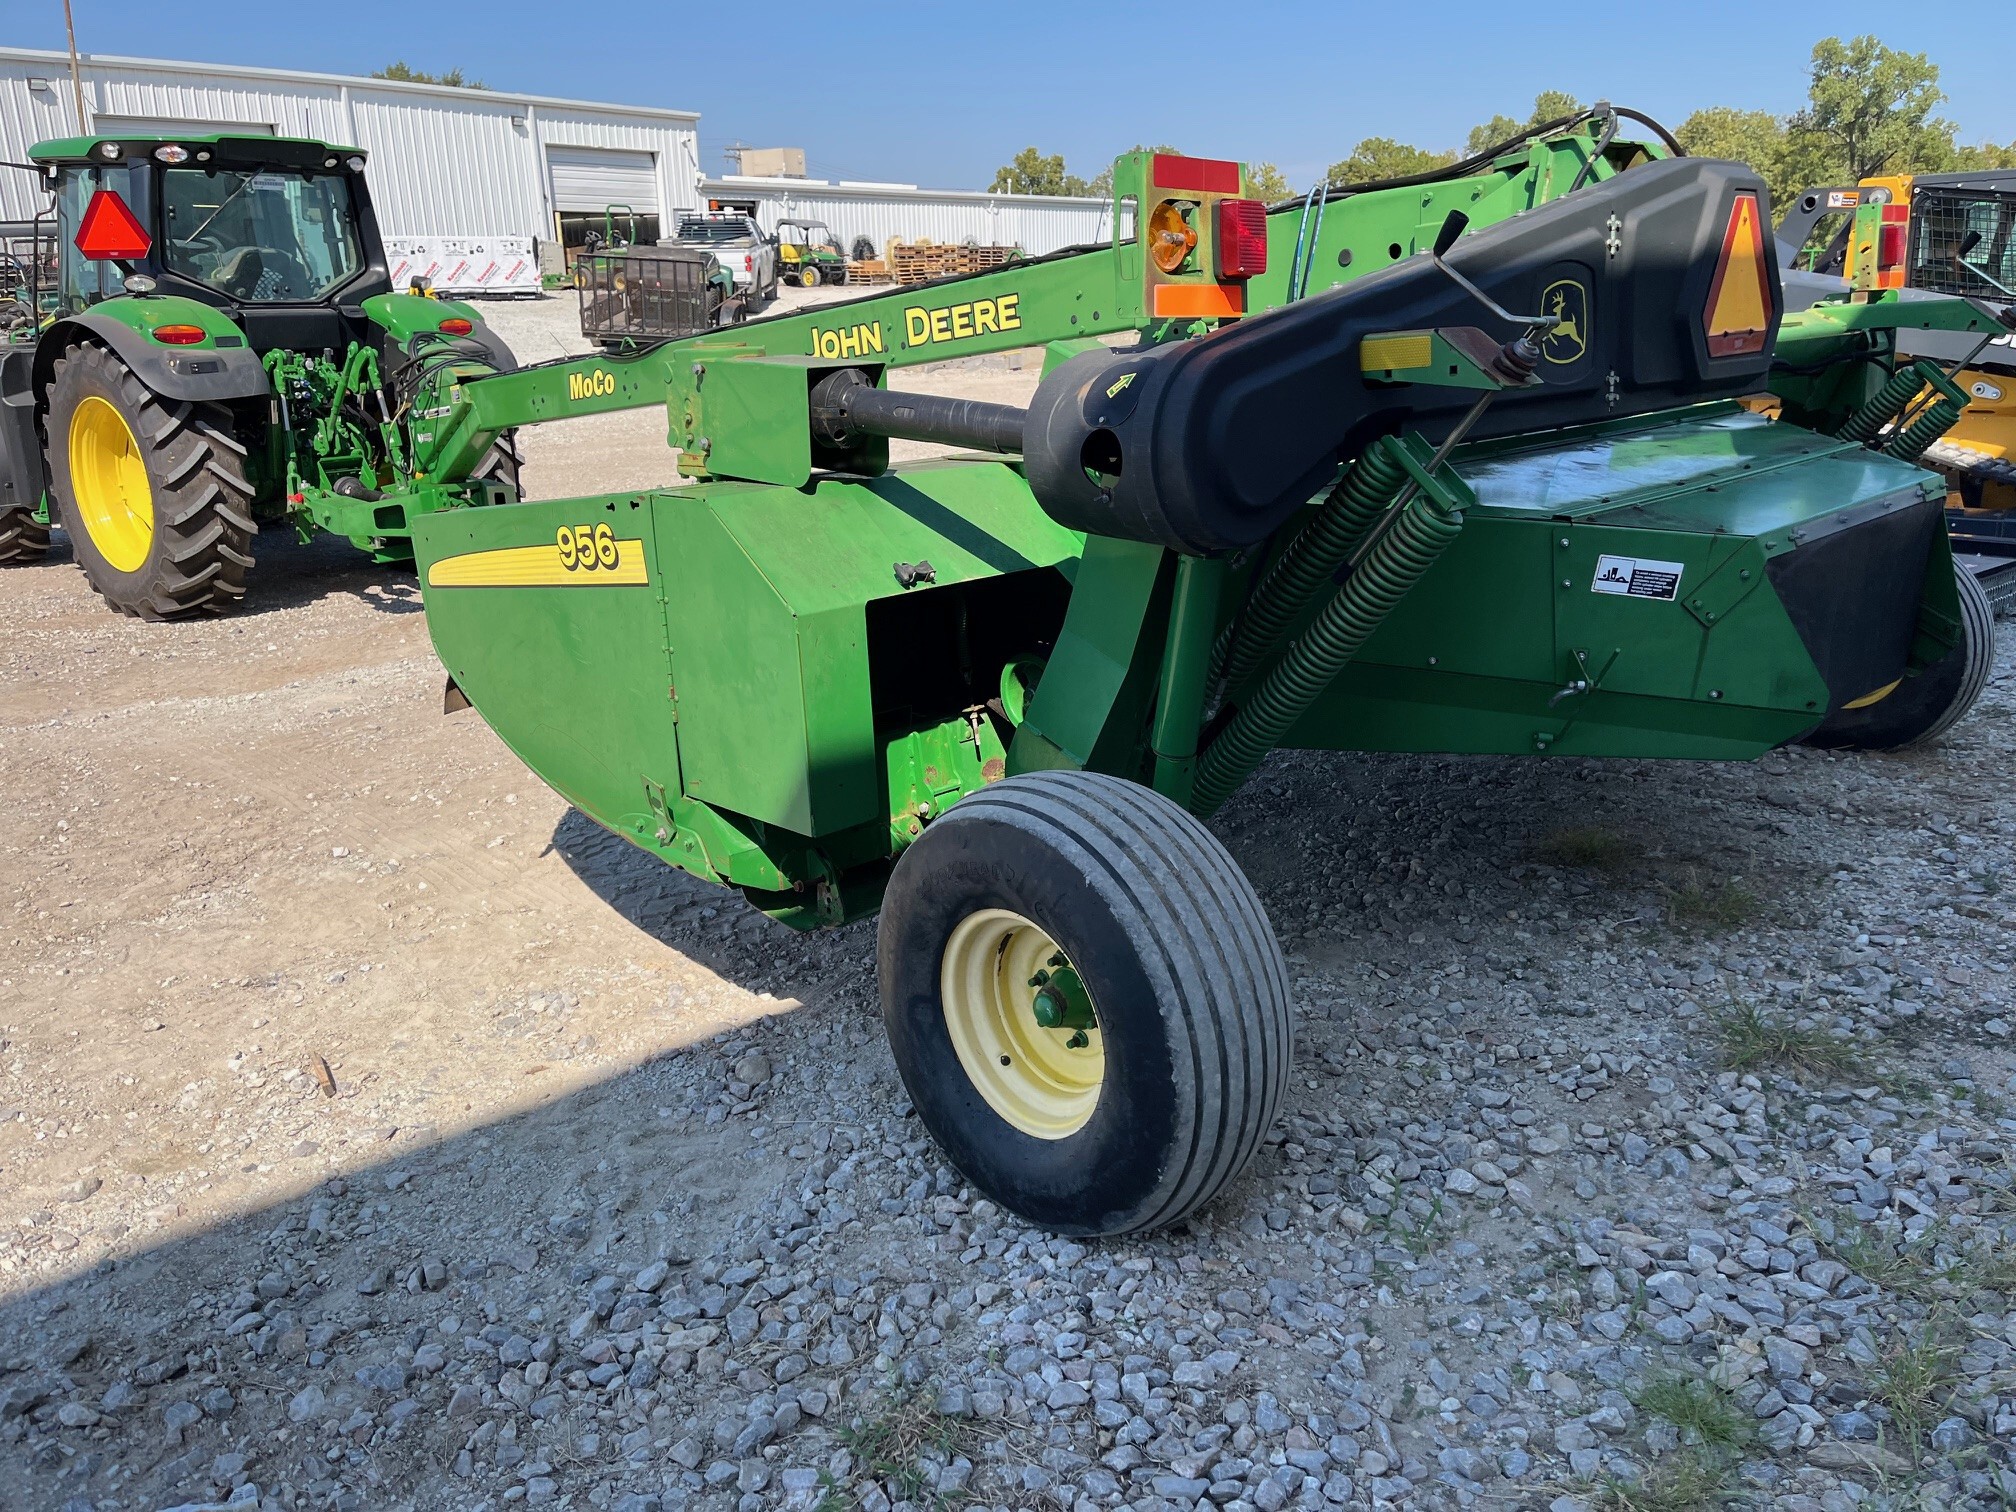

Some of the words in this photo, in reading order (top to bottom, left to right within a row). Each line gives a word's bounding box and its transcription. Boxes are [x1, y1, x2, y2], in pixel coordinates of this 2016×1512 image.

[806, 320, 884, 359] JOHN
[904, 293, 1022, 347] DEERE
[569, 368, 615, 401] MoCo
[556, 521, 619, 572] 956
